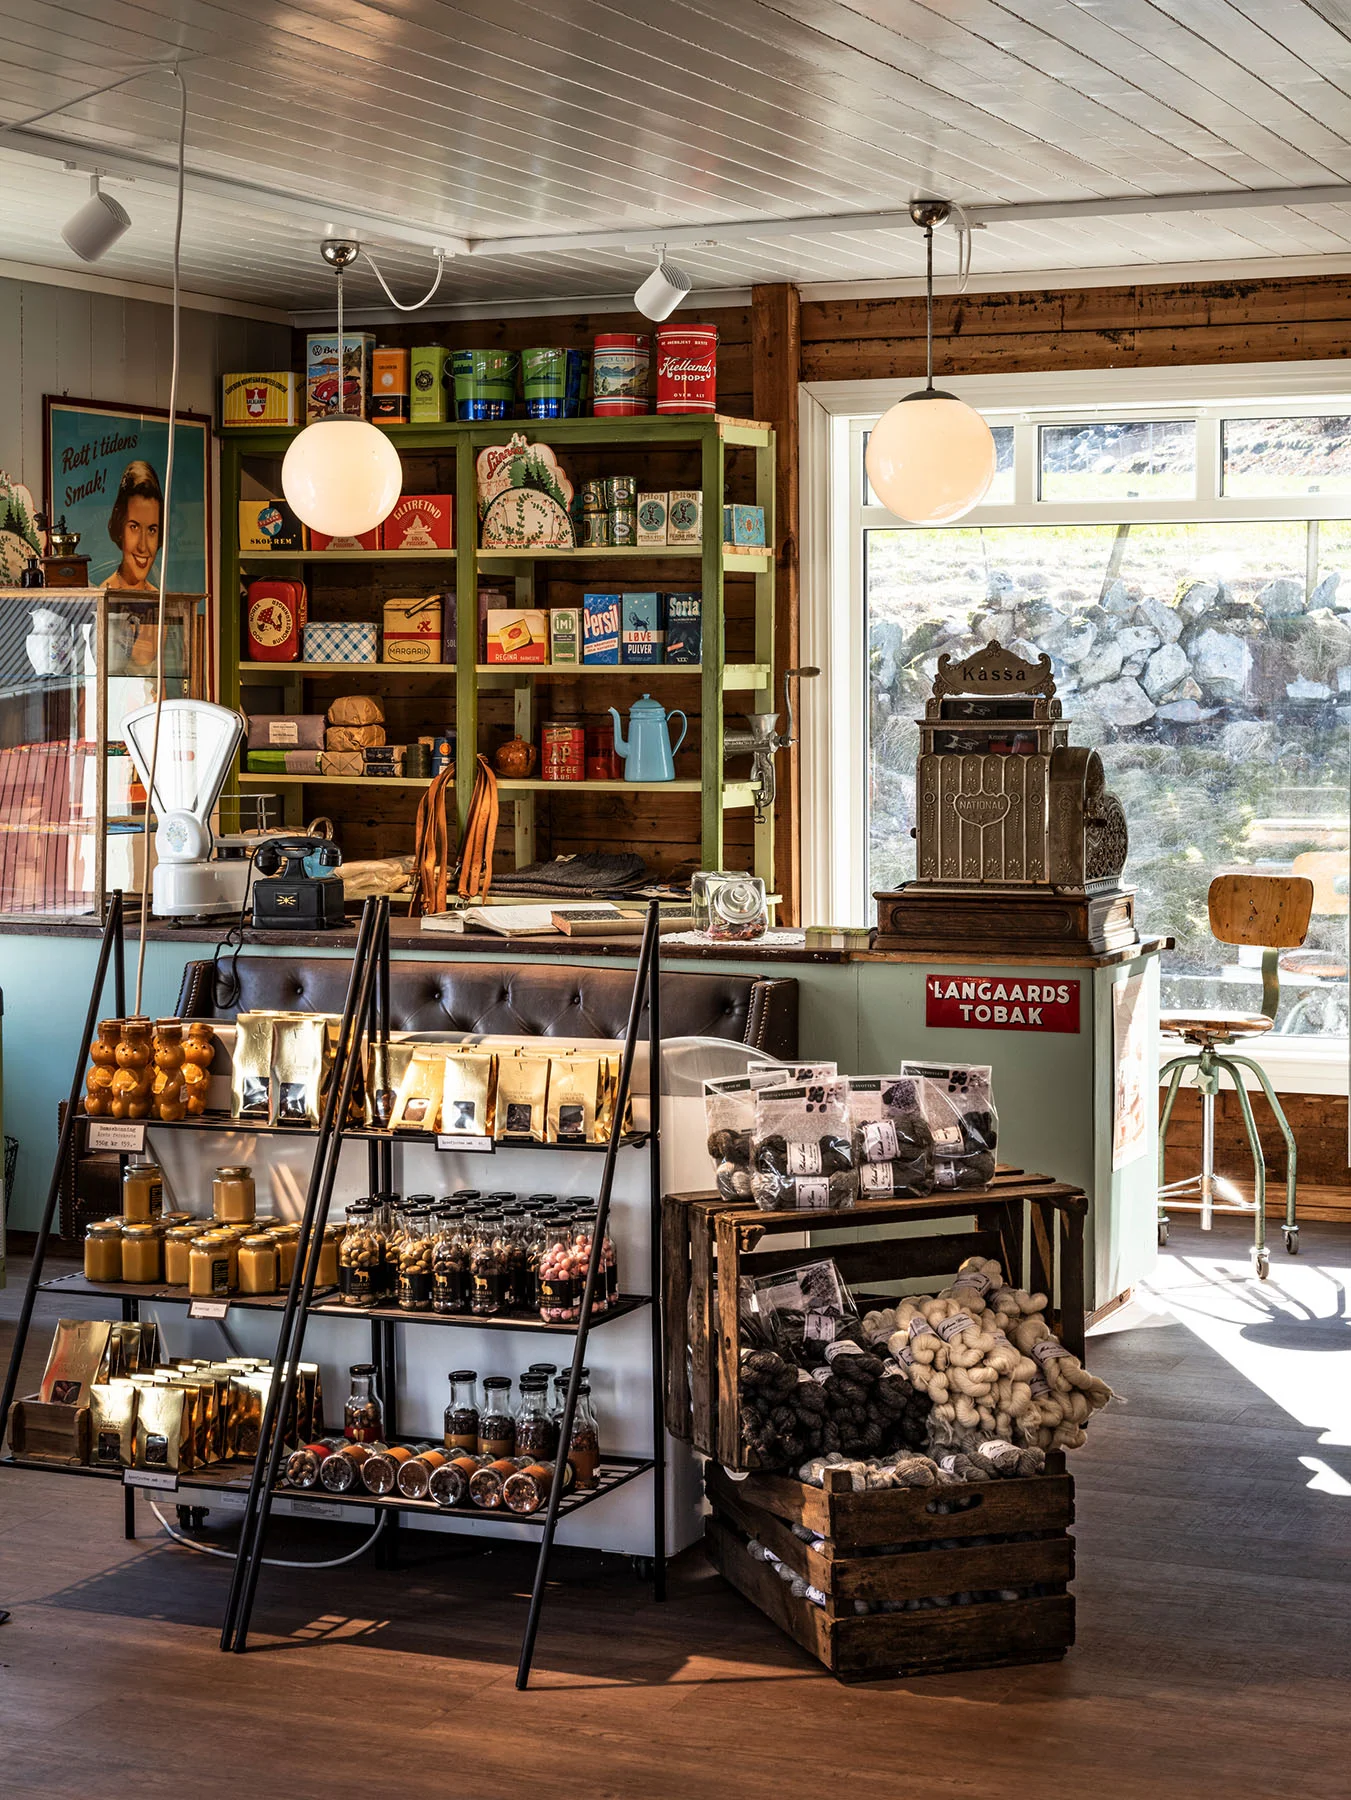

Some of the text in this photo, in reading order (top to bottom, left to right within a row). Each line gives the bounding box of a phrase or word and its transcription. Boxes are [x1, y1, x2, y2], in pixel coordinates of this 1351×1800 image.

[674, 374, 706, 382] DROPS
[62, 433, 138, 474] Rett i tidens
[64, 469, 108, 507] Smak!
[639, 493, 665, 502] Triton
[671, 491, 697, 501] Triton
[393, 500, 441, 521] GLITRETIND
[249, 603, 261, 622] NOREX
[669, 596, 700, 617] Soria
[583, 604, 619, 639] Persil
[252, 630, 263, 642] GOD
[628, 631, 652, 642] LØVE
[389, 647, 429, 655] MARGARIN
[627, 644, 652, 654] PULVER
[495, 653, 518, 661] REGINA
[962, 667, 1026, 681] Kassa
[544, 766, 577, 774] COFFEE
[959, 801, 1004, 811] NATIONAL
[934, 980, 1070, 1004] LANGAARDS
[959, 1004, 1043, 1025] TOBAK
